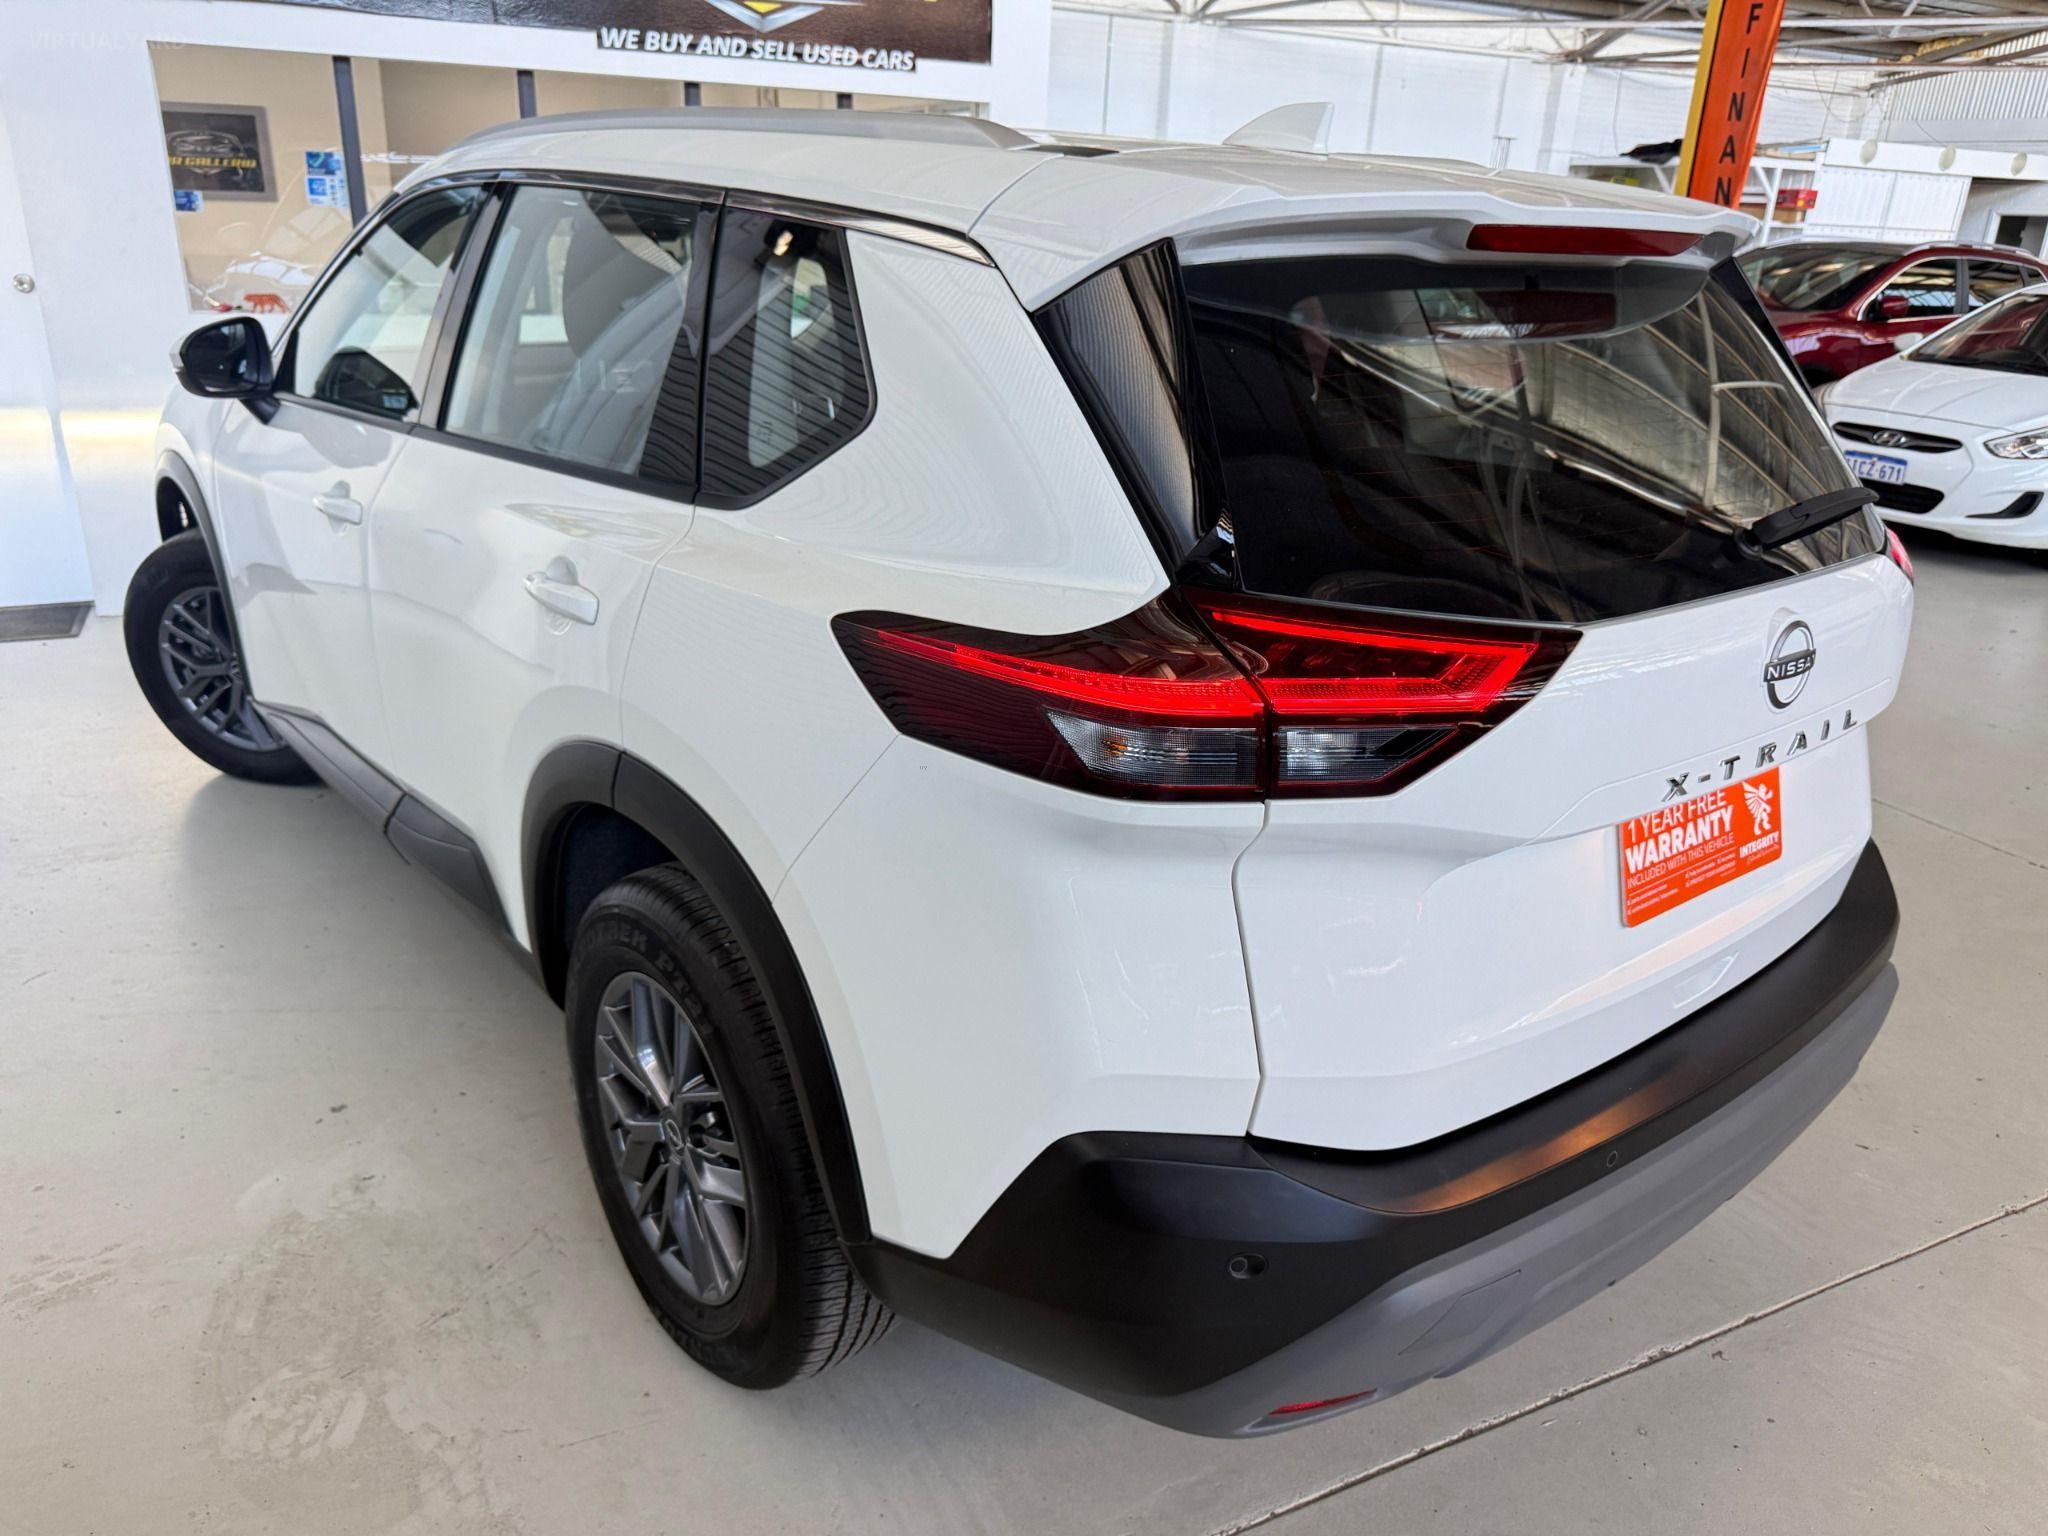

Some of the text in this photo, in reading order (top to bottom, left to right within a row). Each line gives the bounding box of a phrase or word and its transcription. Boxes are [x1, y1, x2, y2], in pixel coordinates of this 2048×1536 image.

[600, 26, 914, 72] WE BUY AND SELL USED CARS
[1661, 709, 1858, 802] X-TRAIL
[1625, 804, 1735, 874] WARRANTY
[1628, 789, 1728, 843] 1 YEAR FREE
[1627, 862, 1667, 889] INCLUDED
[1666, 852, 1687, 871] WITH
[1687, 845, 1705, 863] THIS
[1704, 832, 1735, 855] VEHICLE
[1739, 831, 1779, 859] INTEGRITY
